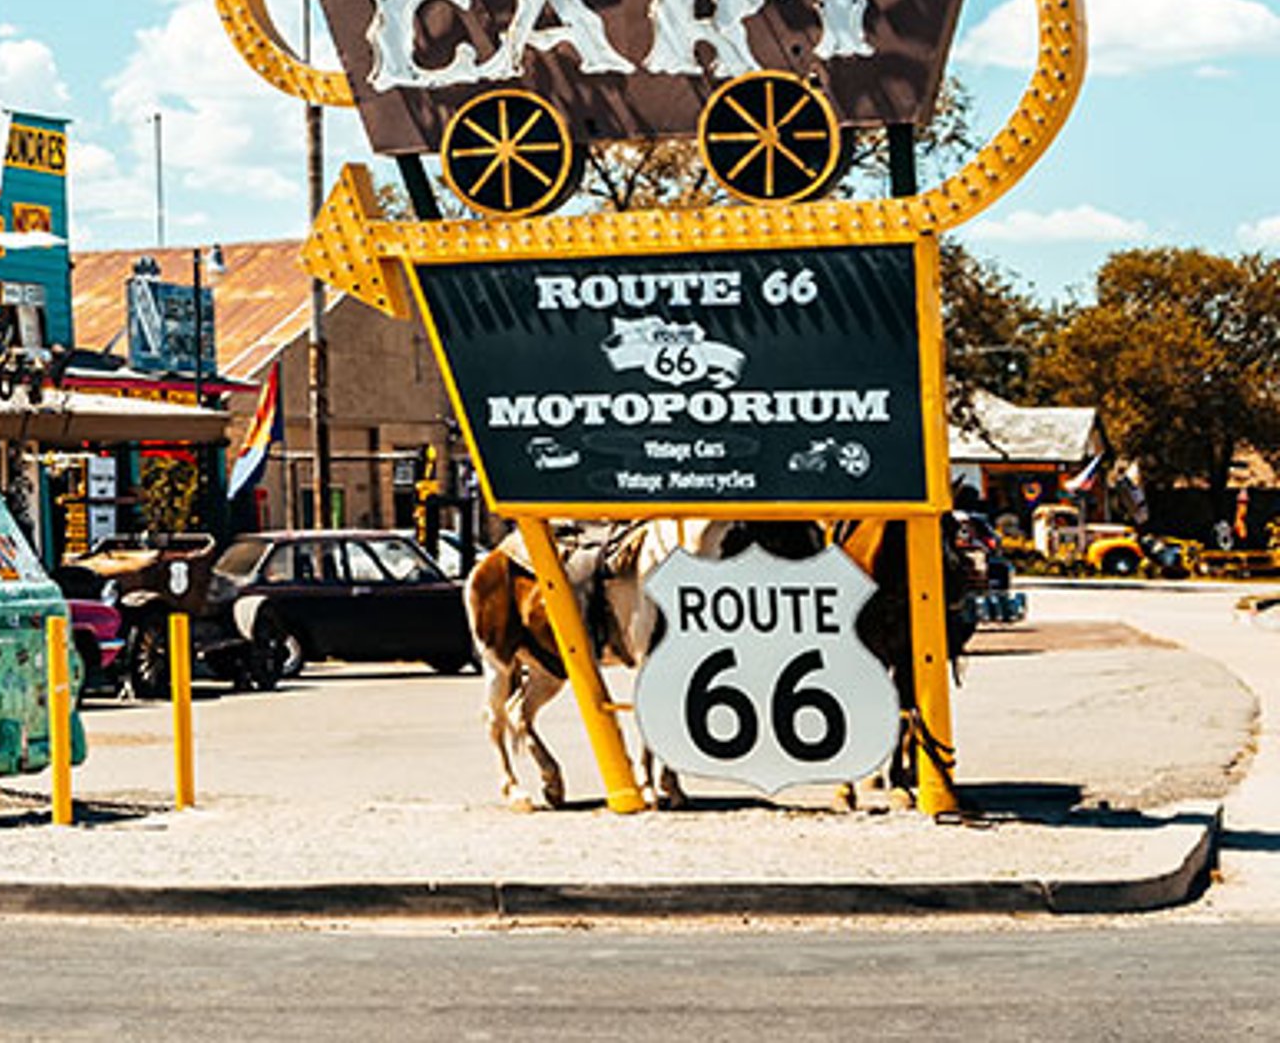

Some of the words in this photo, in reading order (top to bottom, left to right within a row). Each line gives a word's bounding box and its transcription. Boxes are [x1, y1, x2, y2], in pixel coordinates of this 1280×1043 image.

[535, 271, 742, 310] ROUTE
[761, 270, 819, 307] 66
[656, 347, 697, 376] 66
[487, 390, 891, 427] MOTOPORIUM
[644, 440, 690, 462] Vintage
[693, 440, 726, 458] Cars
[616, 472, 663, 493] Vintage
[667, 469, 757, 493] Motorcycles
[679, 586, 840, 634] ROUTE
[684, 648, 848, 763] 66
